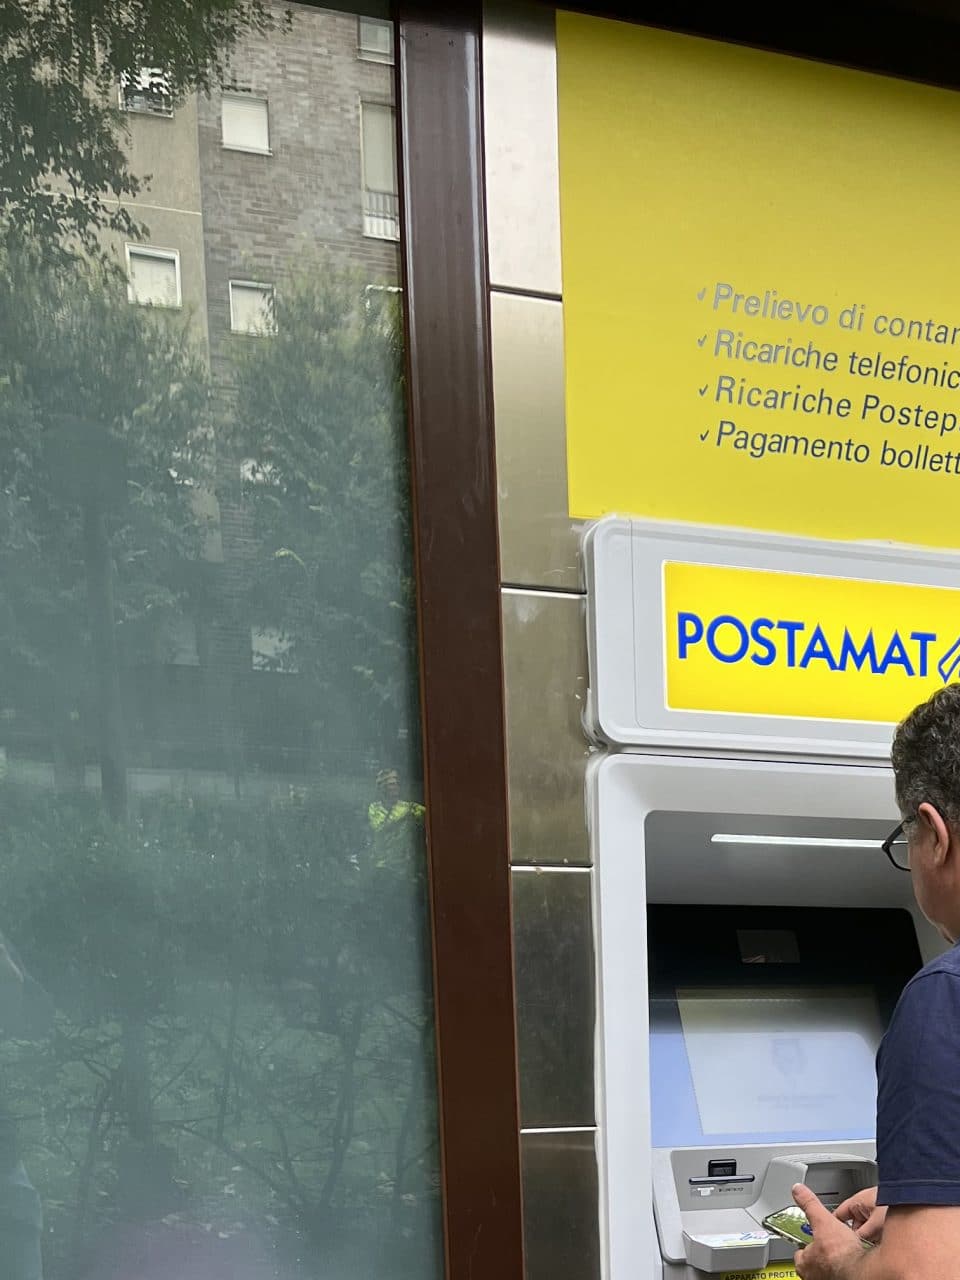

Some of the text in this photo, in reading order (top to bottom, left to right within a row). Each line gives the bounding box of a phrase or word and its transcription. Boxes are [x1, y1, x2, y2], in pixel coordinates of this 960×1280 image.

[712, 283, 829, 325] Prelievo
[838, 303, 867, 331] di
[713, 329, 839, 372] Ricariche
[714, 375, 852, 418] Ricariche
[716, 420, 871, 463] Pagamento
[677, 611, 936, 677] POSTAMAT
[768, 1270, 797, 1279] PROTE
